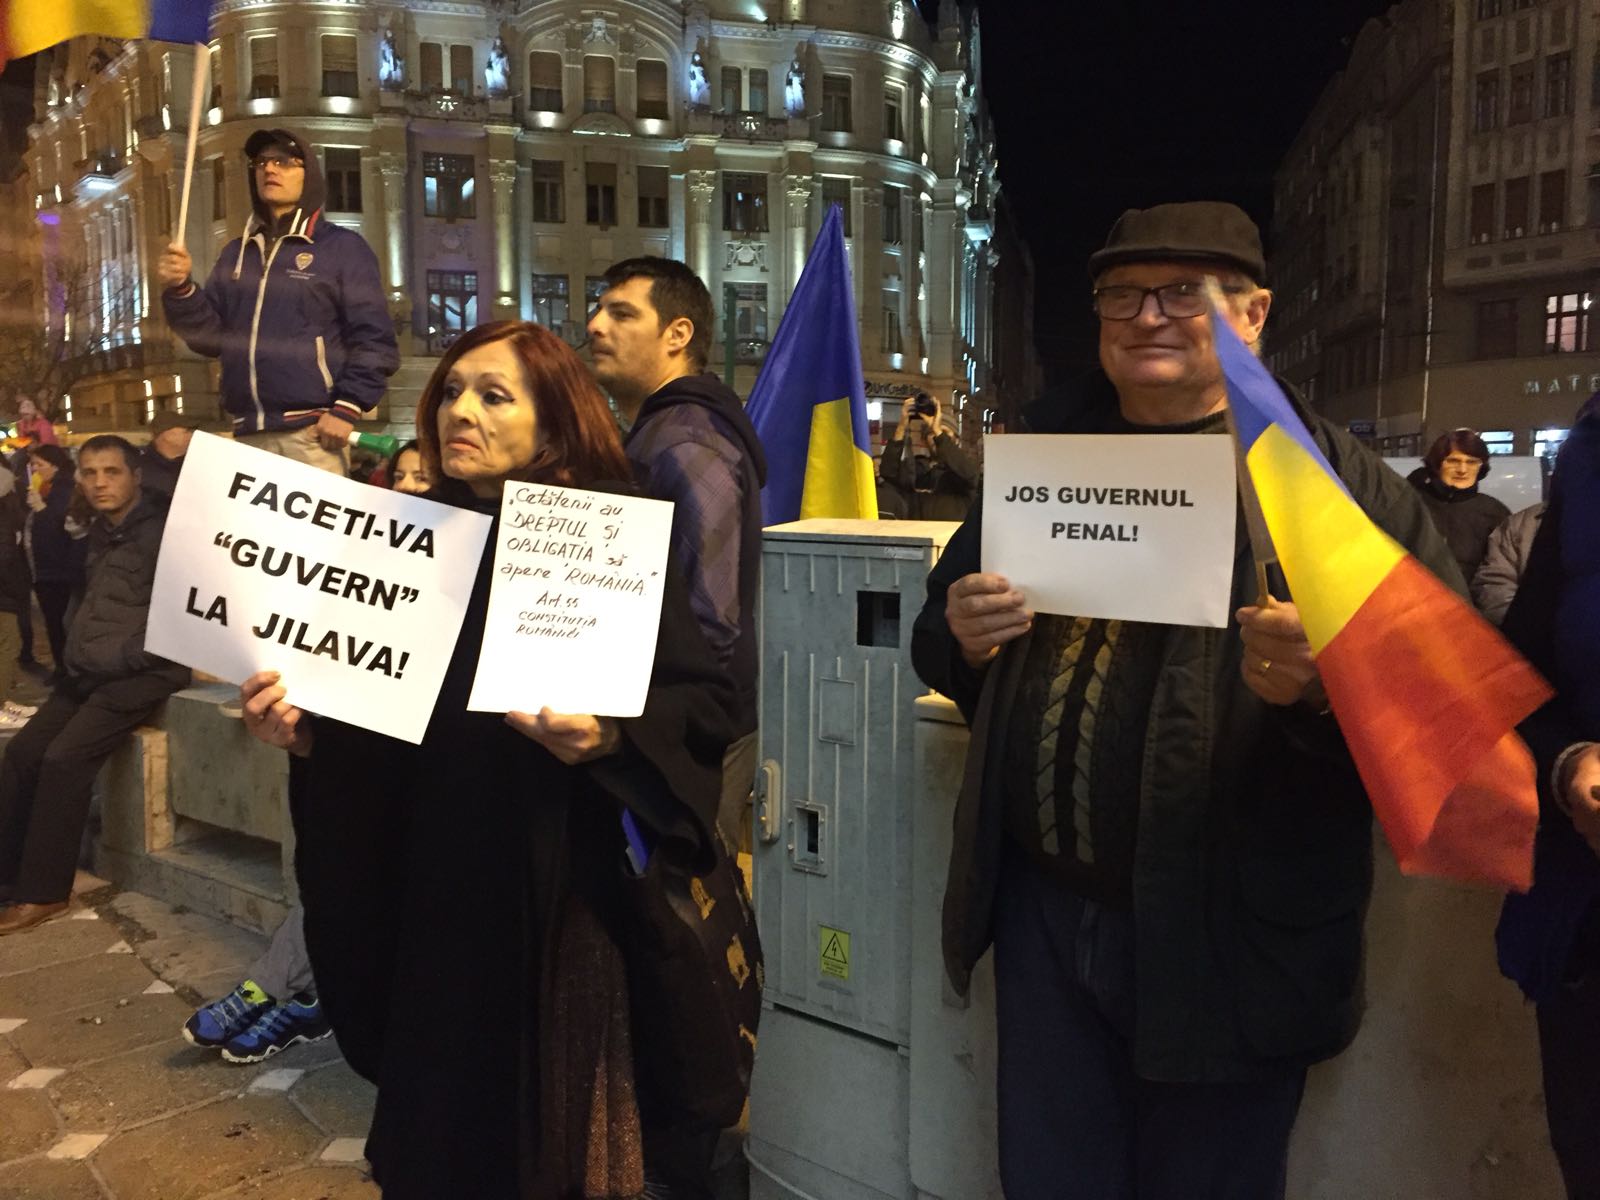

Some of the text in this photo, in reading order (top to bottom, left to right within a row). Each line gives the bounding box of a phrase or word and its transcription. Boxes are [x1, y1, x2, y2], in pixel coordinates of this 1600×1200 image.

[1005, 486, 1194, 507] JOS GUVERNUL
[228, 471, 434, 559] FACETI-VA
[599, 503, 623, 516] au
[505, 511, 588, 538] DREPTUL
[1051, 522, 1139, 542] PENAL!
[500, 562, 551, 582] apere
[185, 586, 410, 680] LA JILAVA!
